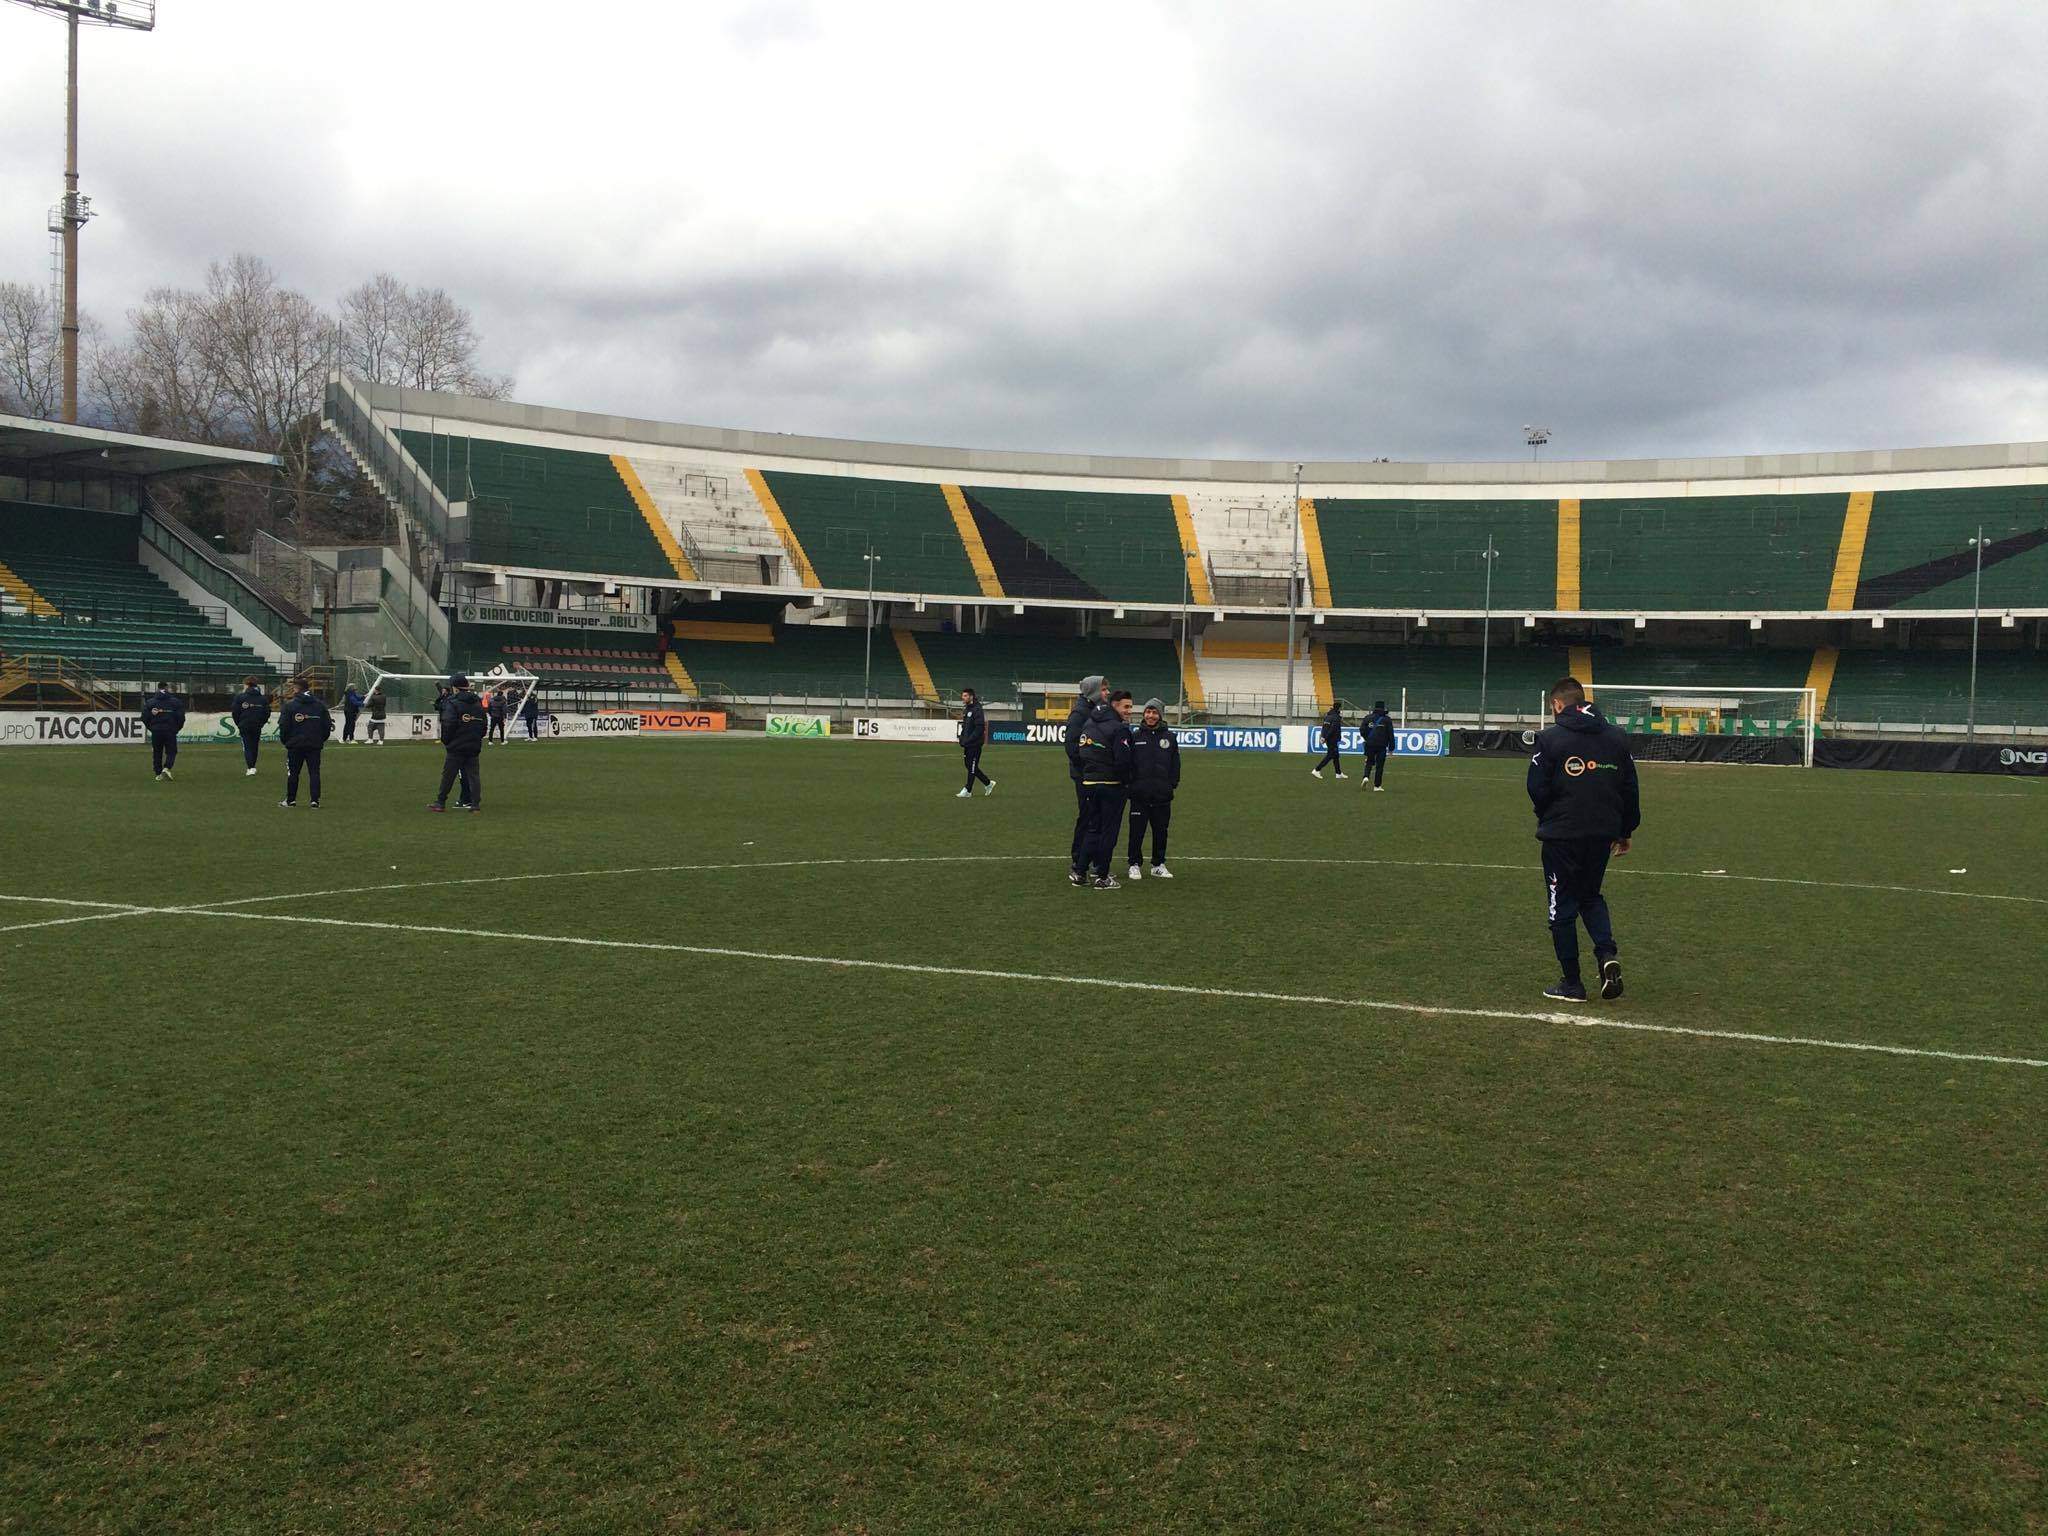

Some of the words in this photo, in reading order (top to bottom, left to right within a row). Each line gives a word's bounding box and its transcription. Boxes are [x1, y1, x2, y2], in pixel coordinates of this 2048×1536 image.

[480, 607, 554, 624] BIANCOVERDI
[35, 716, 143, 739] TACCONE
[561, 722, 588, 732] GRUPPO
[590, 717, 638, 732] TACCONE
[1213, 730, 1278, 748] TUFANO
[1314, 731, 1423, 751] RSPTO
